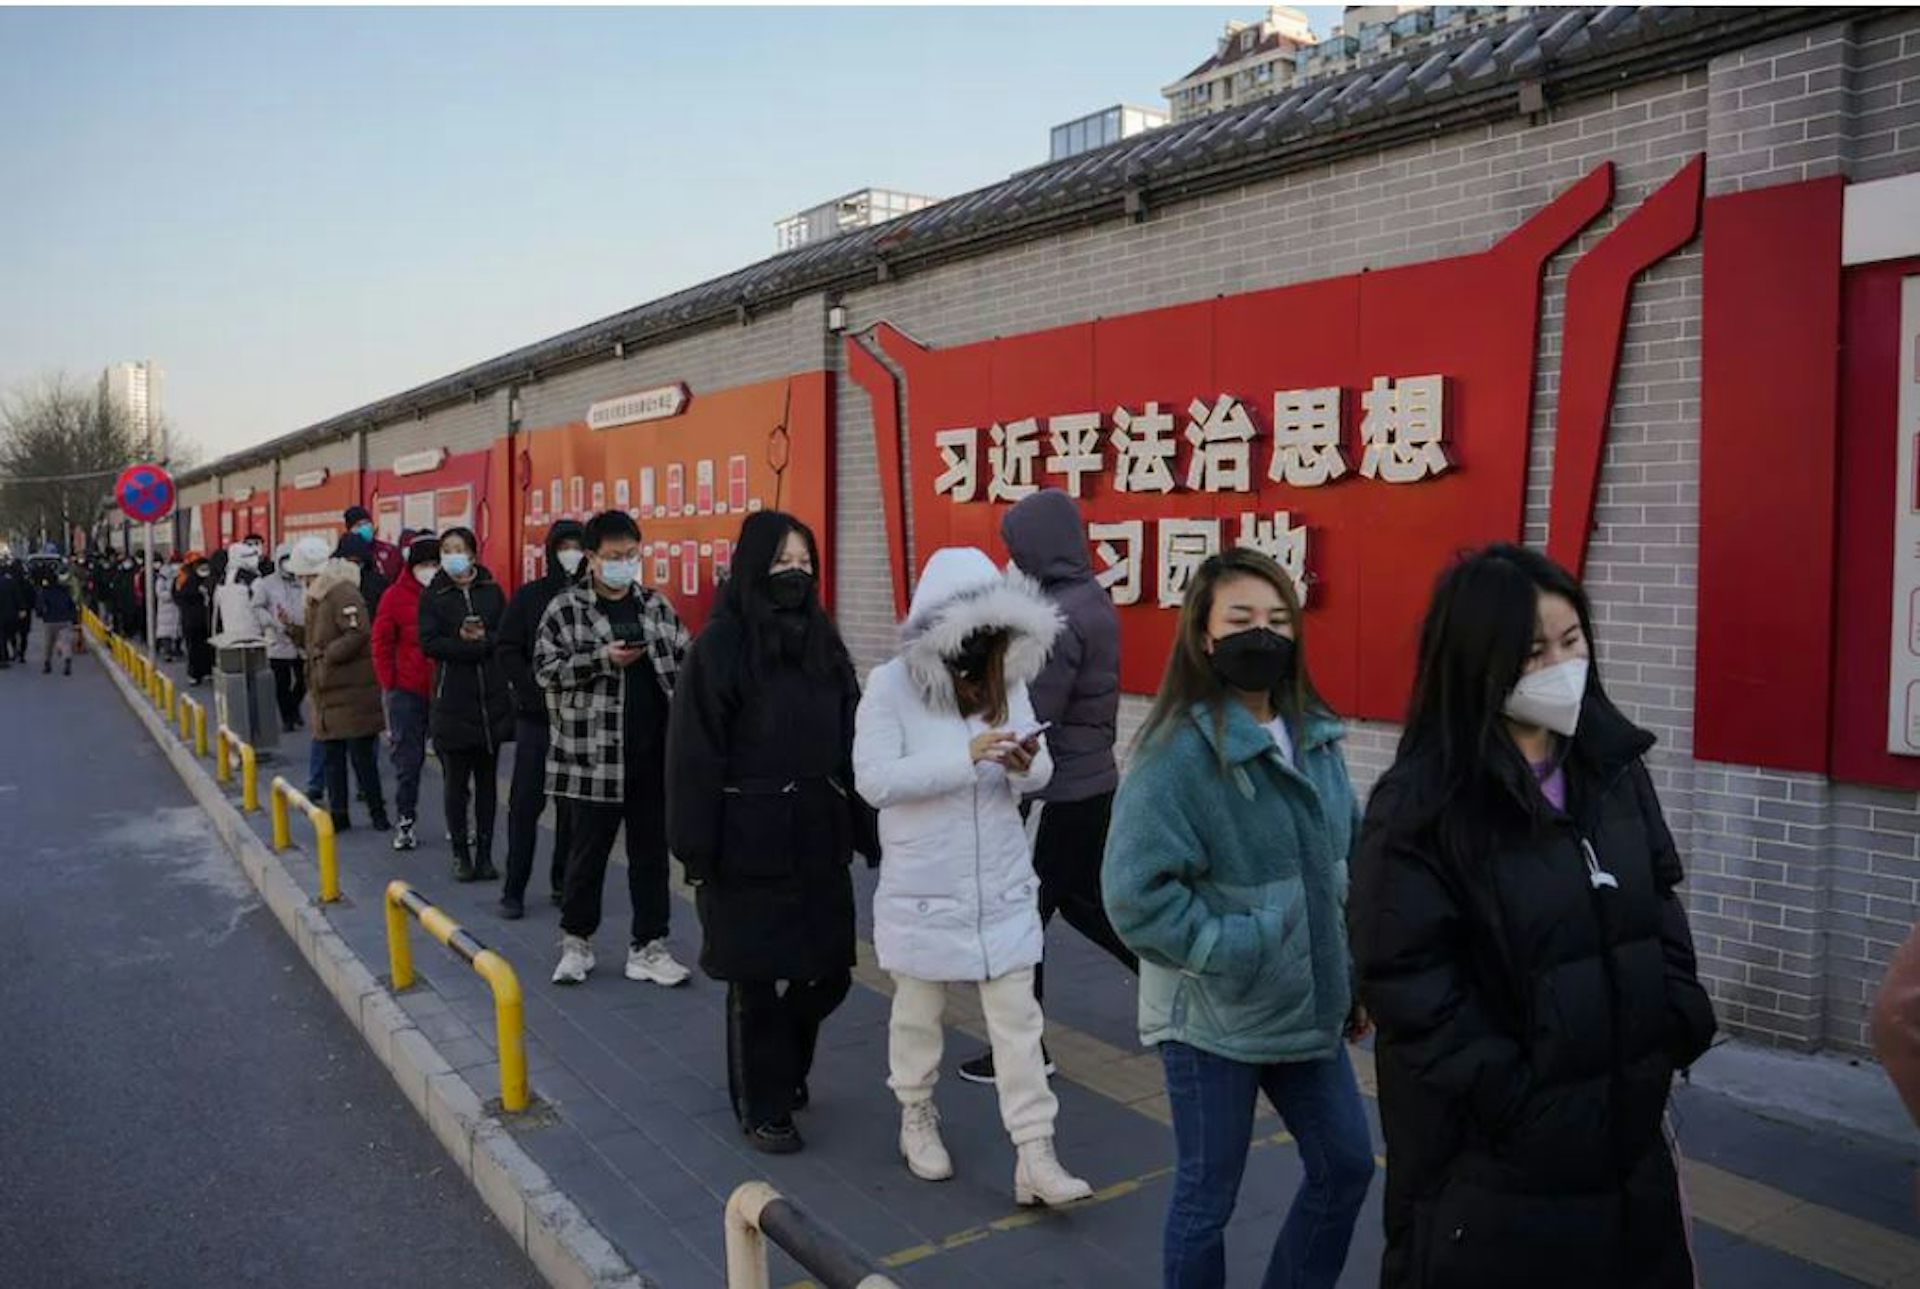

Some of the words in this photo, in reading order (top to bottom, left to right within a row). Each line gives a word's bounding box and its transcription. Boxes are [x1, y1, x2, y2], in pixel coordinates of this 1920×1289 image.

[934, 374, 1448, 504] 习近平法治思想
